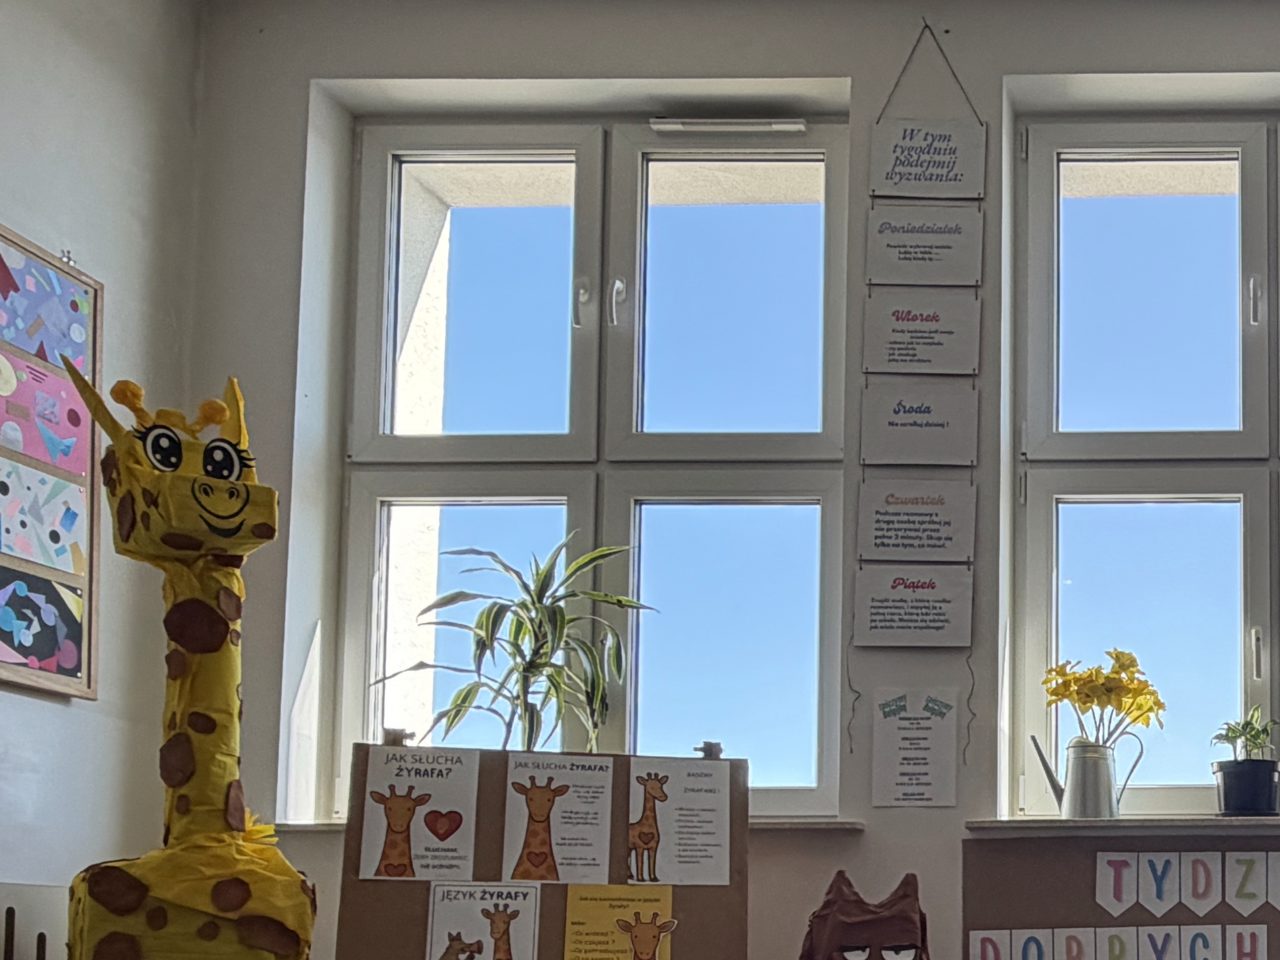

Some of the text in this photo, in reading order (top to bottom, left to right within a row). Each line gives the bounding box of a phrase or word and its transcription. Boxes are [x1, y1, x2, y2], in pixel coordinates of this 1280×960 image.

[902, 128, 952, 147] W tym
[892, 143, 957, 159] tygodniu
[892, 155, 958, 172] podejmij
[892, 310, 940, 322] Wtorek
[893, 400, 932, 414] Środa
[891, 577, 936, 592] Piątek
[384, 753, 464, 767] JAK SŁUCHA
[514, 761, 530, 770] JAK
[532, 762, 567, 770] SŁUCHA
[395, 765, 453, 779] ŻYRAFA?
[441, 889, 529, 903] JĘZYK ŻYRAFY
